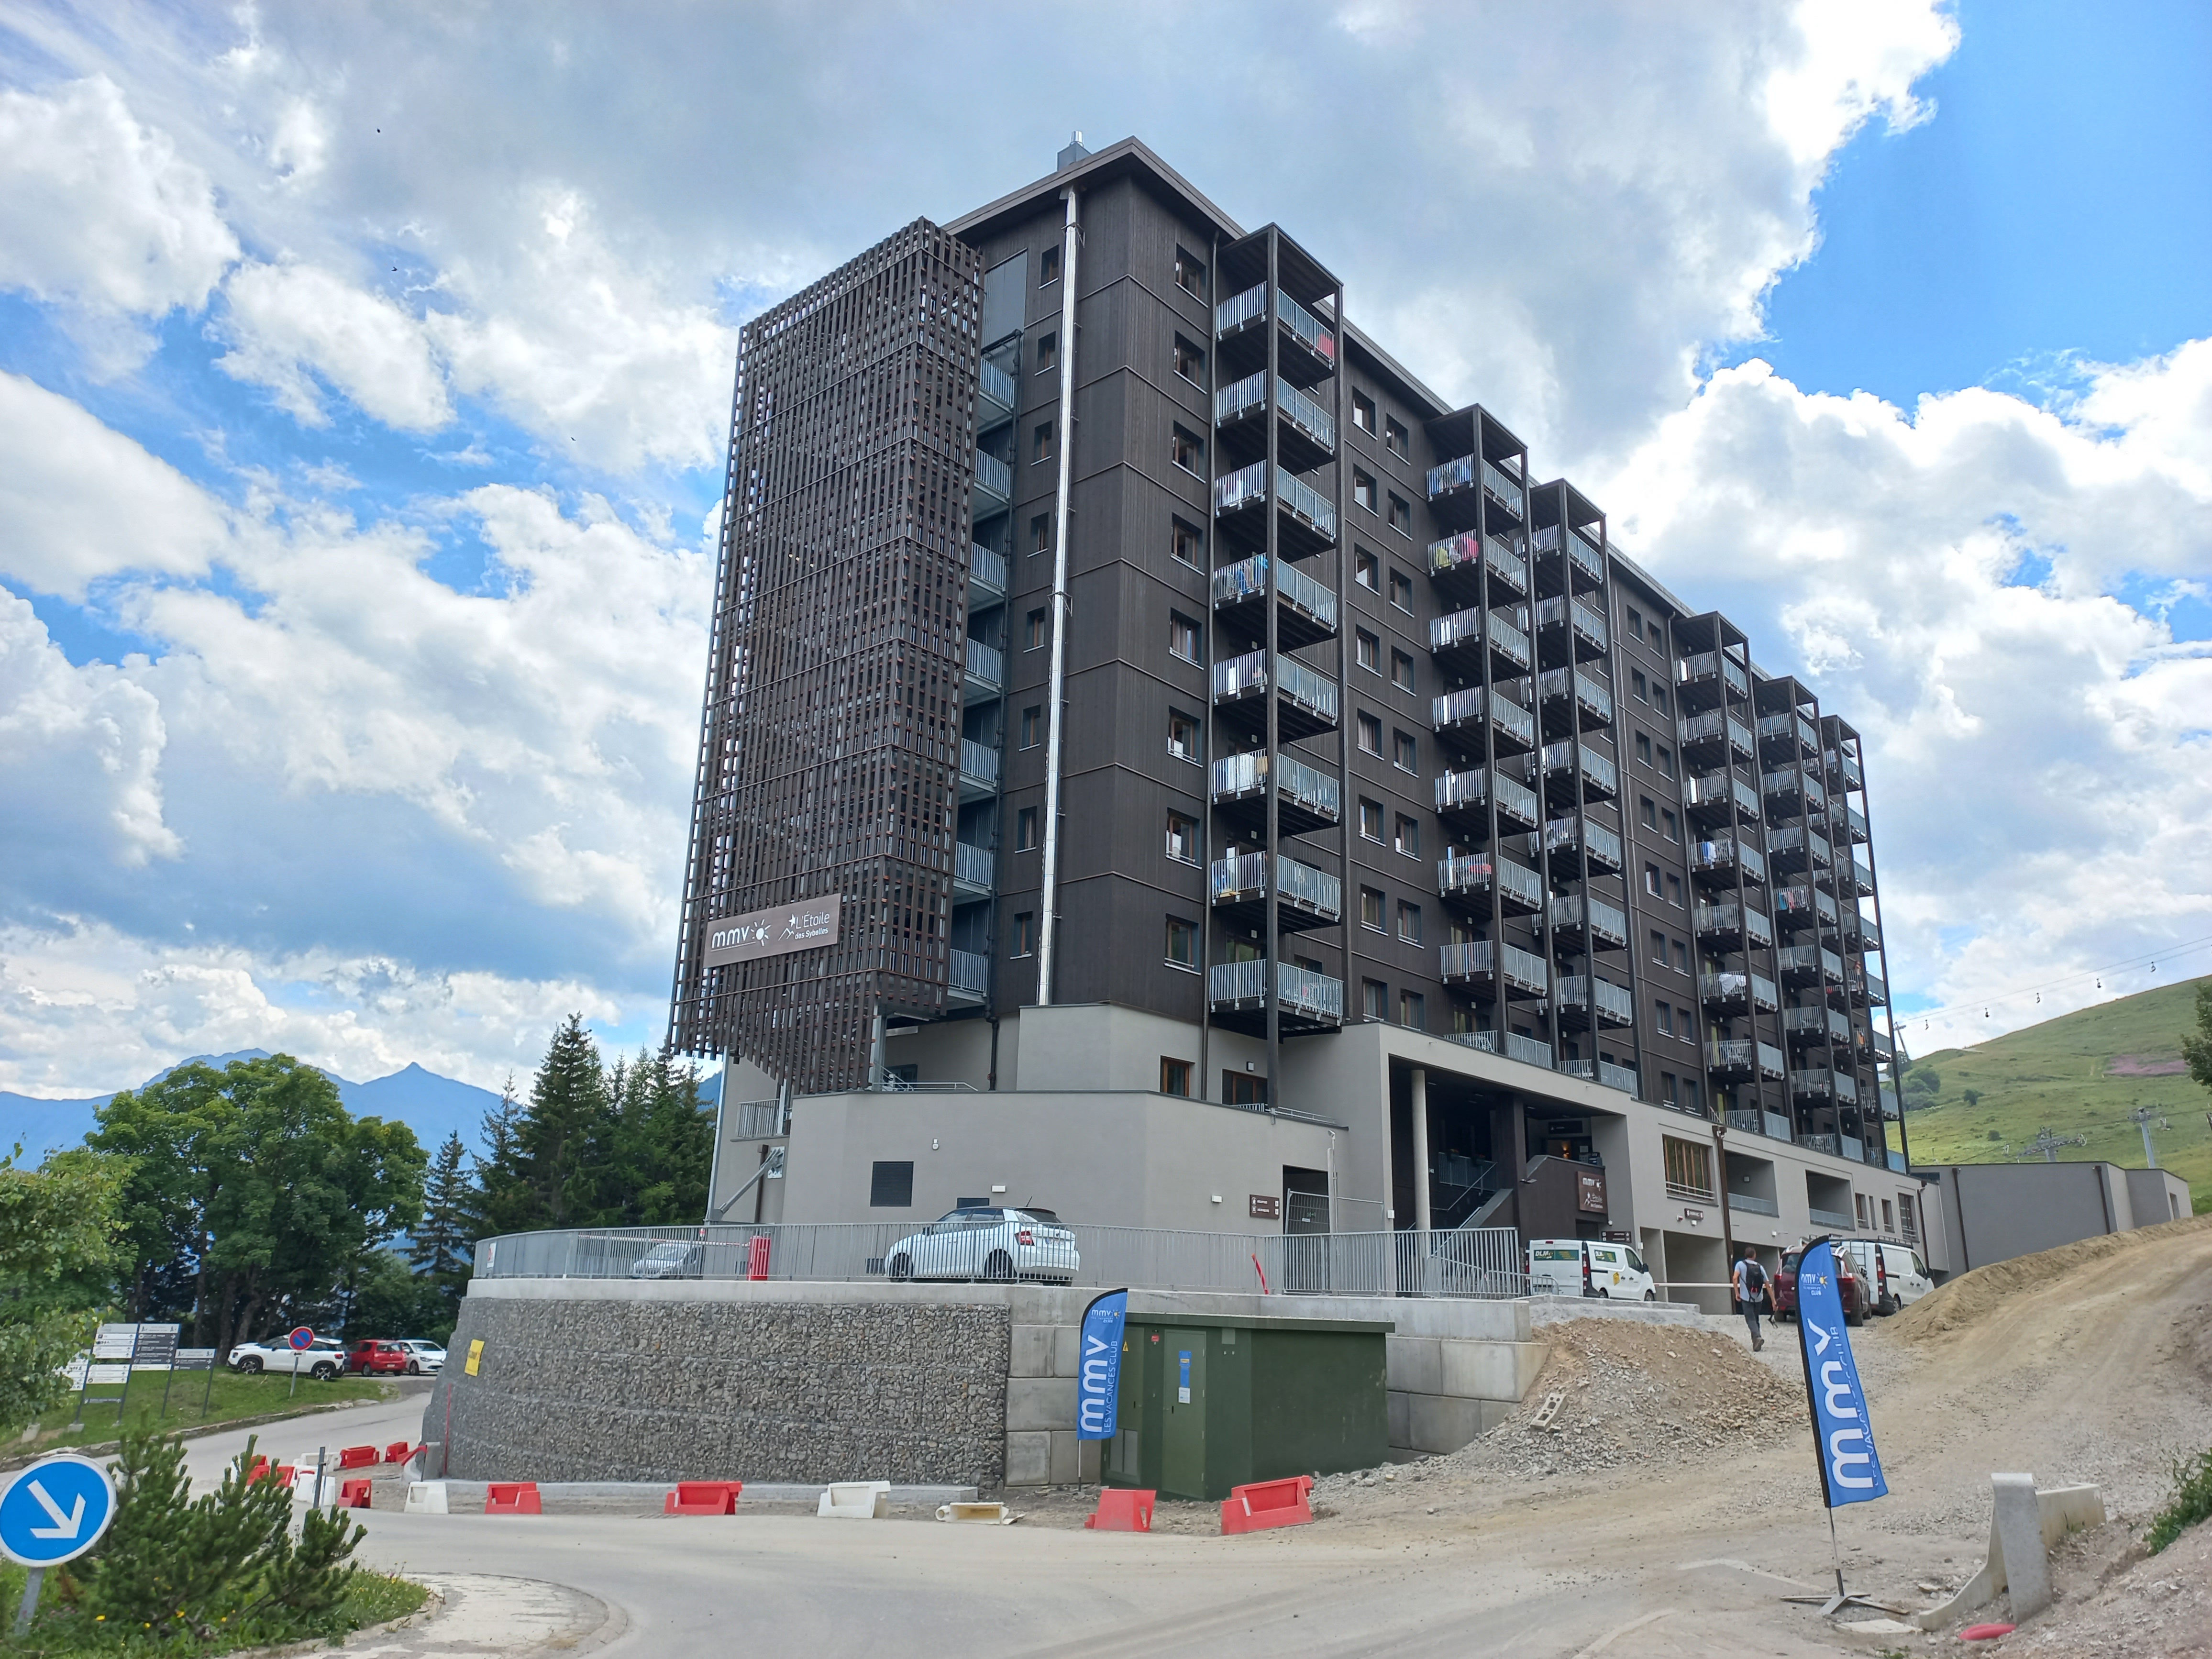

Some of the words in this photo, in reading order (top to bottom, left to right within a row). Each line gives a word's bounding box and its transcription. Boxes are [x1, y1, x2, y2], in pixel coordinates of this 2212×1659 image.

[795, 910, 830, 929] L'Étoile
[711, 925, 750, 949] mmv
[794, 931, 805, 940] des
[805, 927, 829, 938] Sybelles
[1108, 1340, 1118, 1365] CLUB
[1080, 1334, 1109, 1433] mmv
[1105, 1367, 1116, 1416] VACANCES
[1807, 1317, 1874, 1489] mmv
[1103, 1417, 1112, 1434] LES
